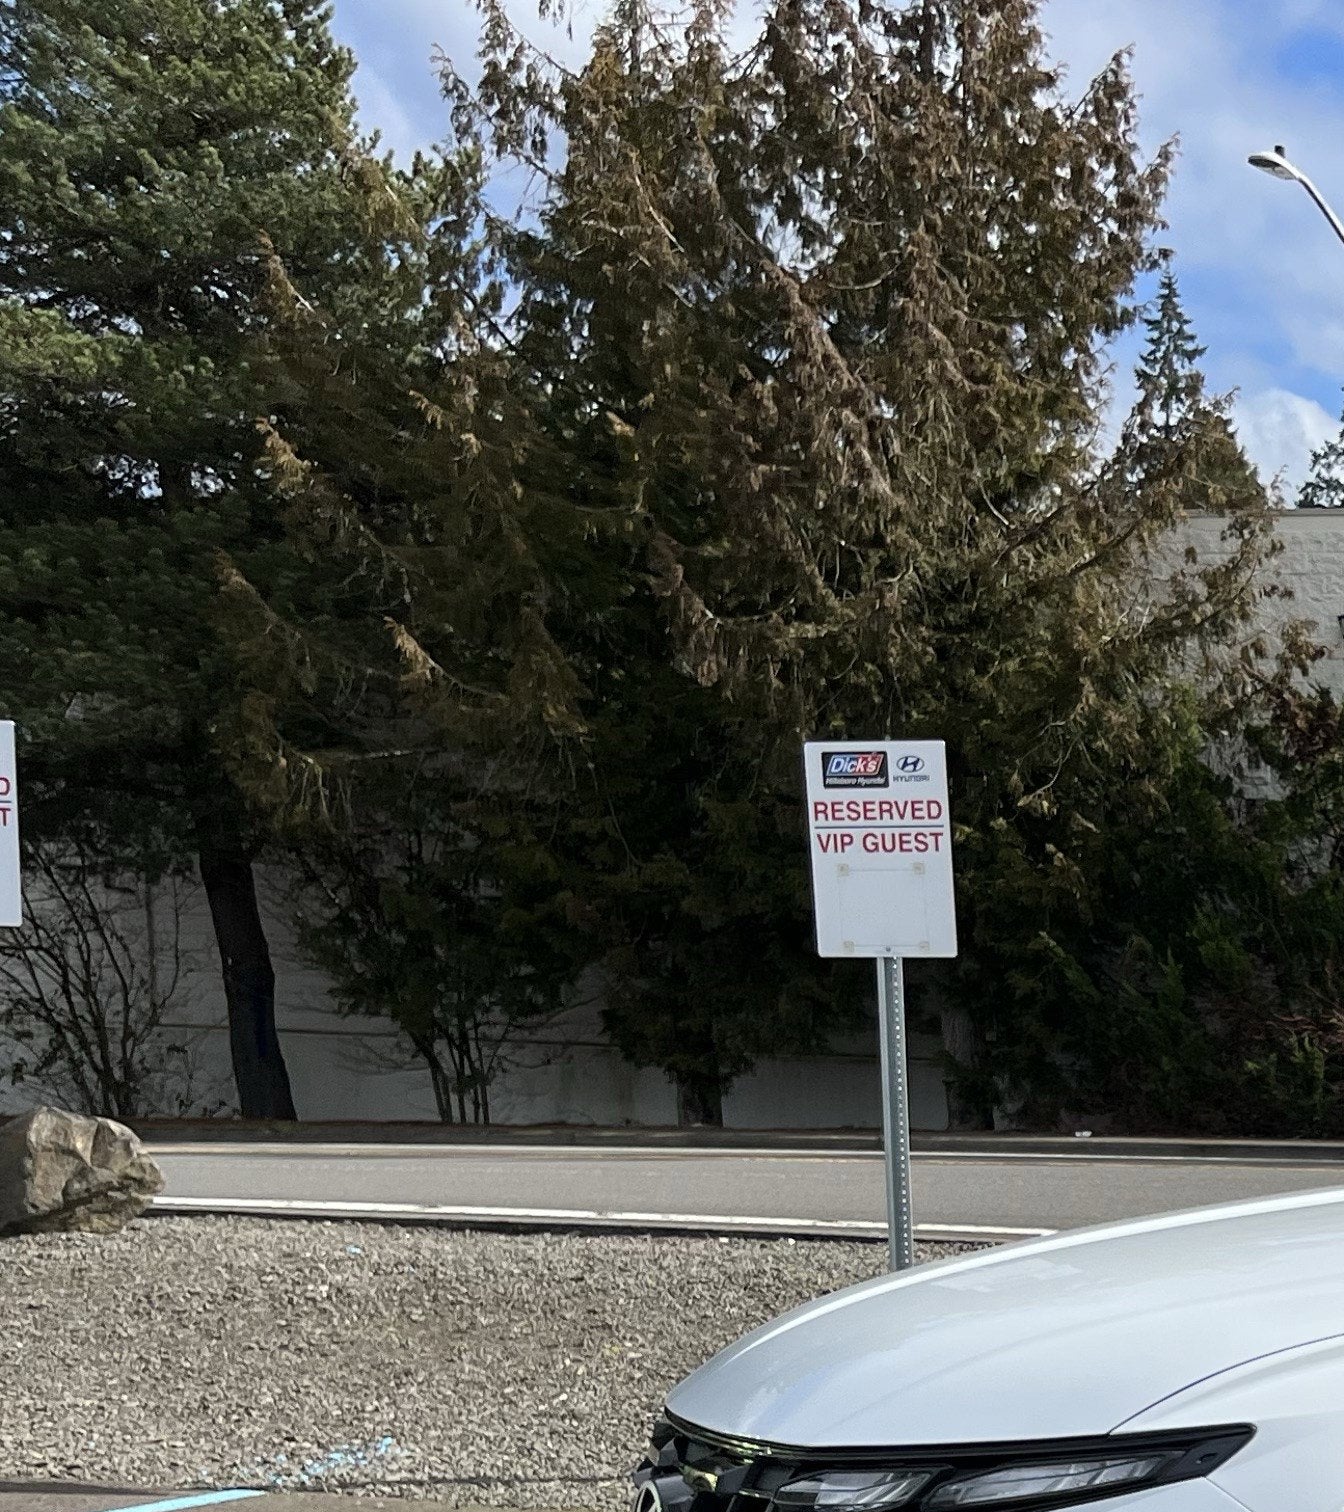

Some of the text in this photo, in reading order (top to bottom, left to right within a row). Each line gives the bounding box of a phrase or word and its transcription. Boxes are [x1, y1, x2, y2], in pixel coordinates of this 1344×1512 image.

[813, 800, 943, 821] RESERVED
[817, 832, 944, 853] VIP GUEST
